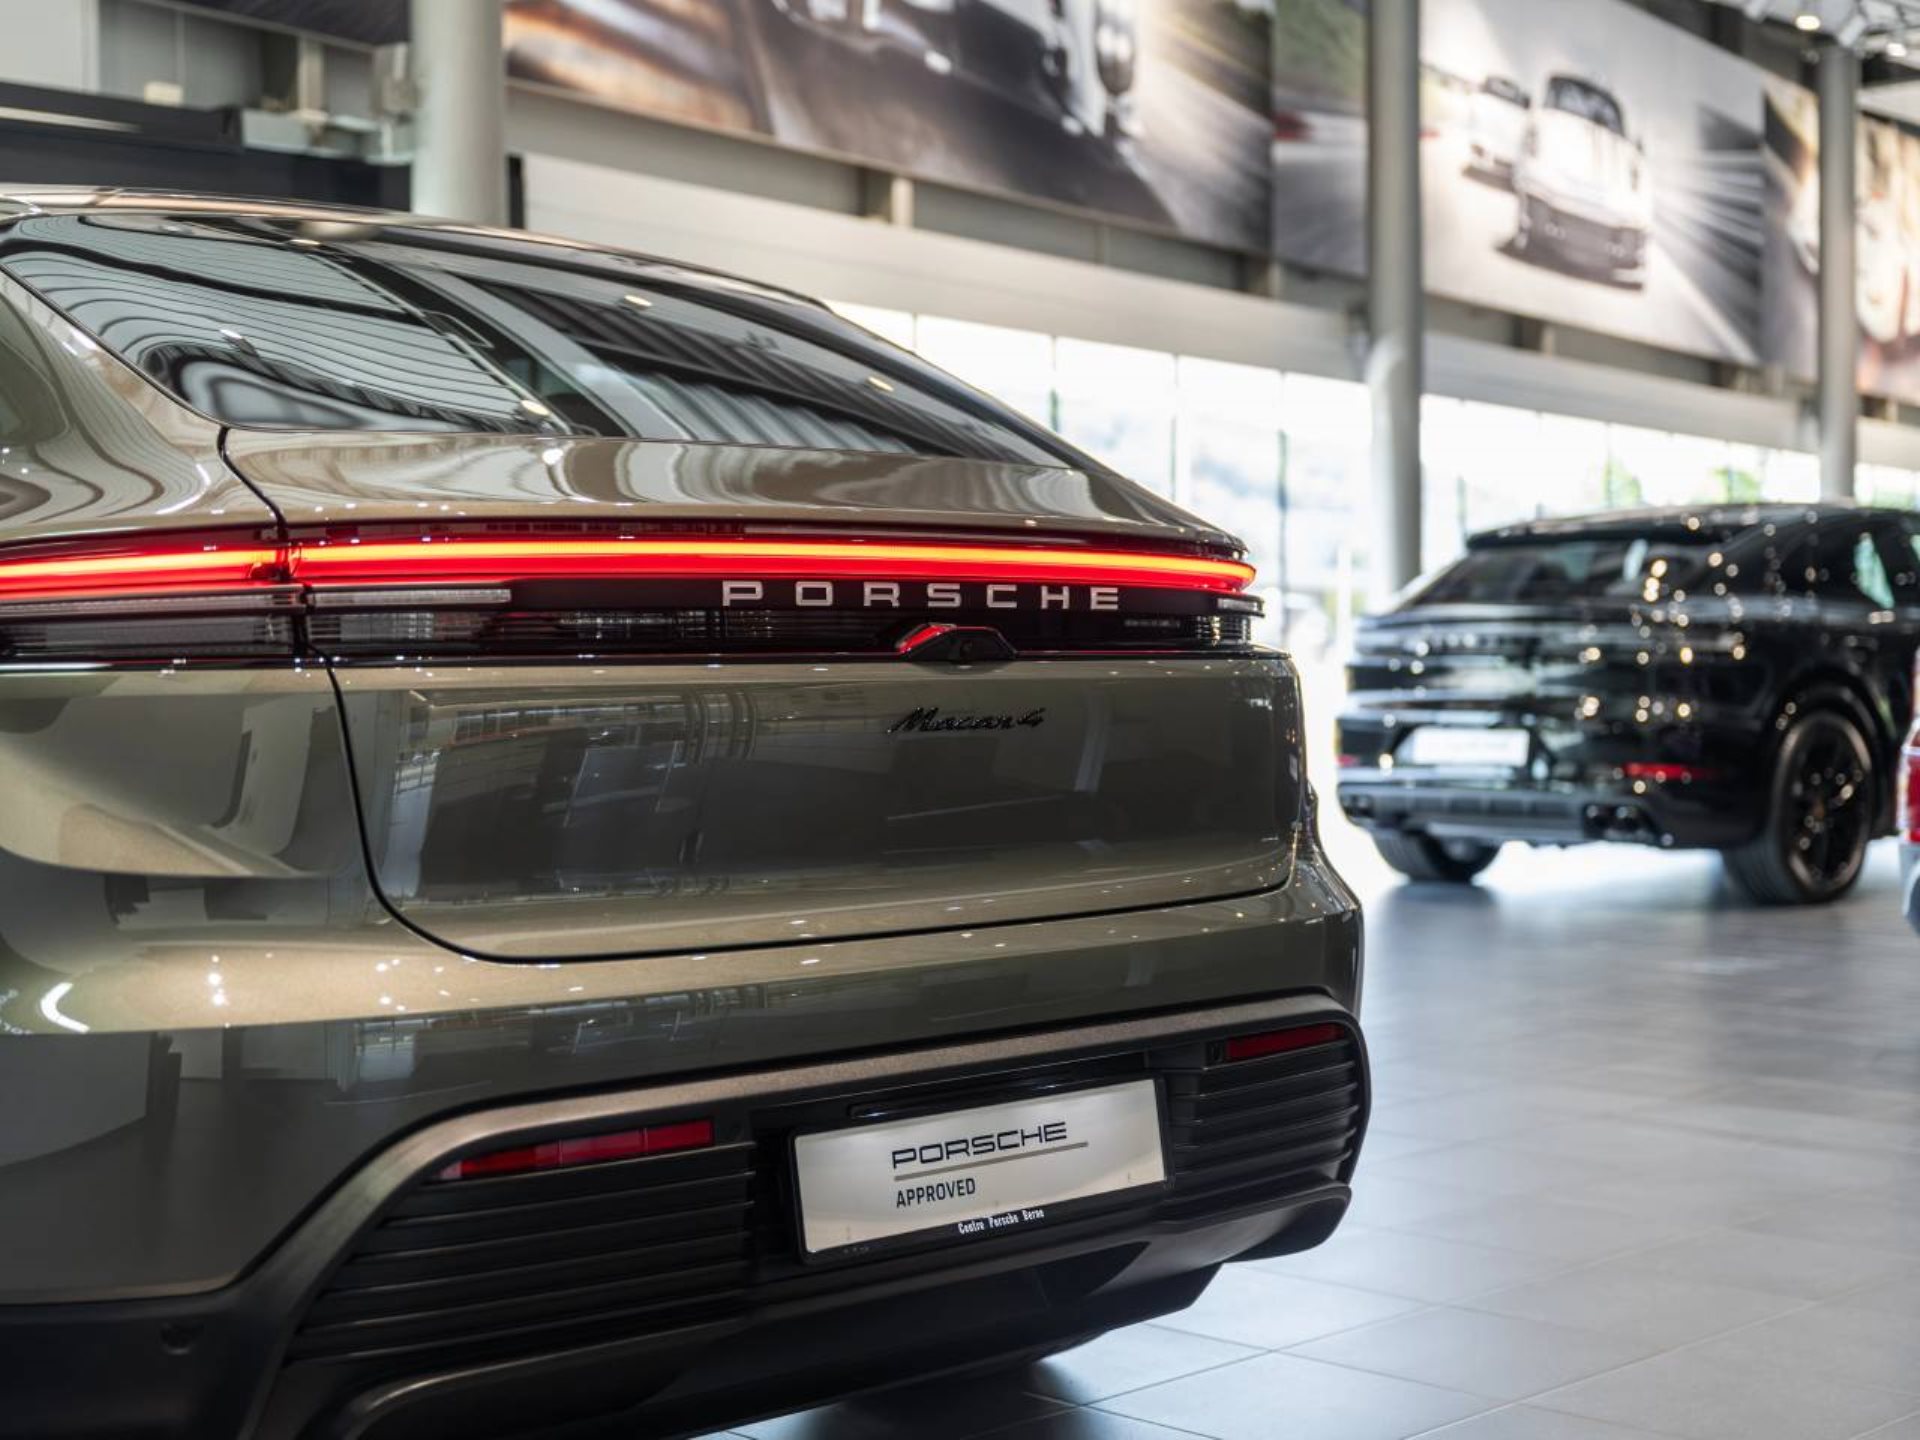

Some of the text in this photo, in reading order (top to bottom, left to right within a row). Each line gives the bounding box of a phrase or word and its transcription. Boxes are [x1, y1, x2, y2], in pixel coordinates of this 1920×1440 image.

[721, 580, 1120, 611] PORSCHE
[887, 707, 1046, 733] Macan 4
[891, 1121, 1068, 1170] PORSCHE
[896, 1177, 976, 1209] APPROVED
[987, 1212, 1019, 1229] Porsche
